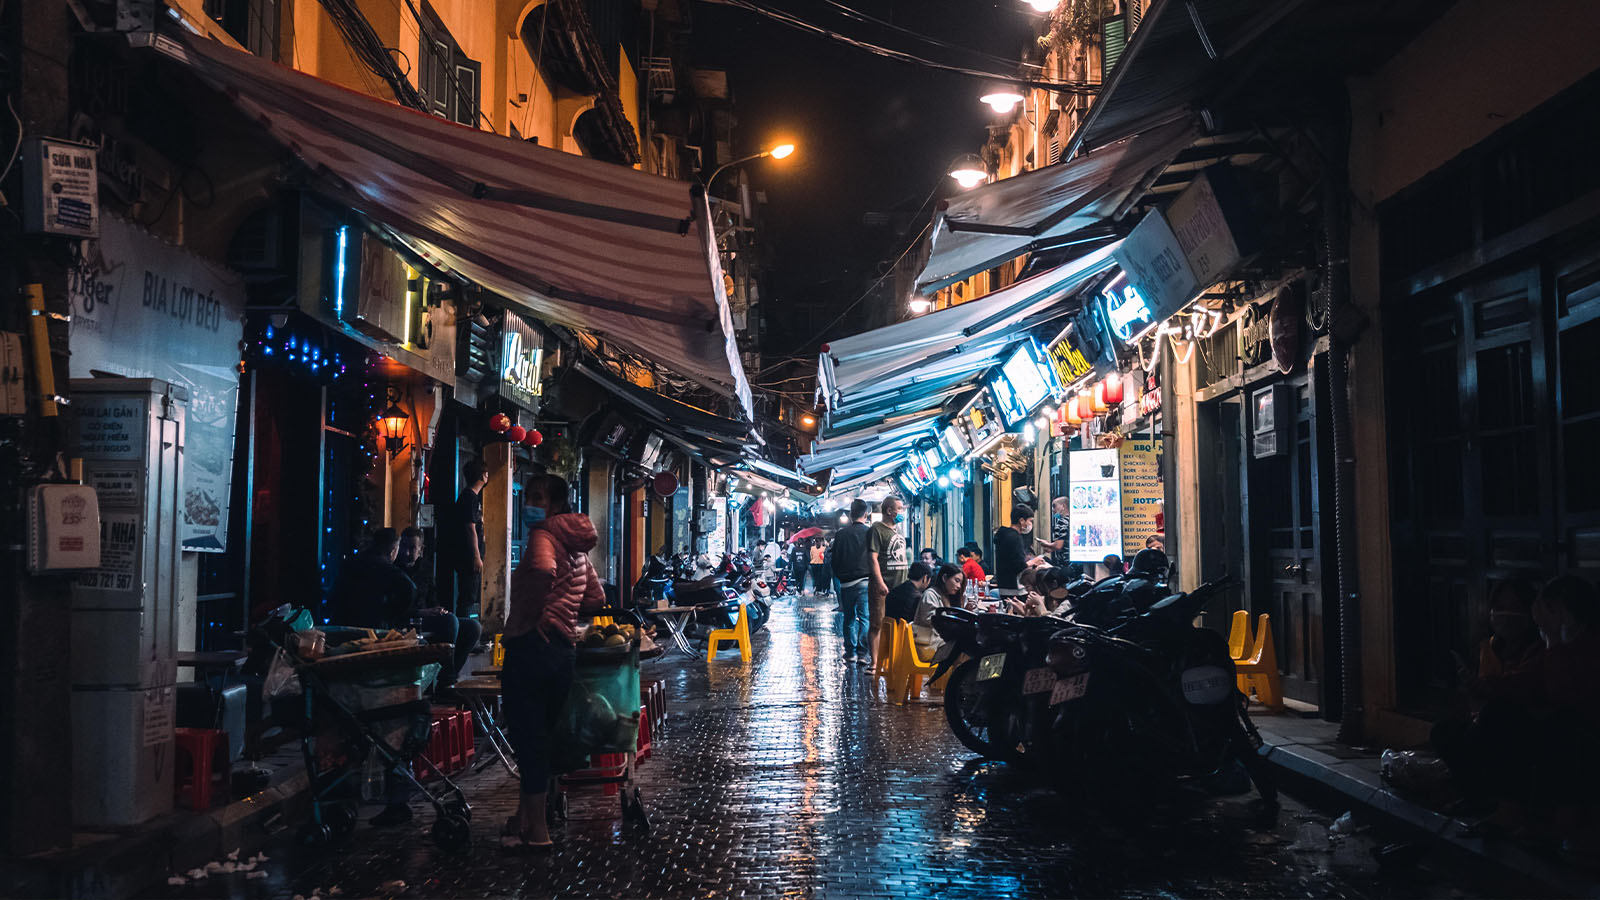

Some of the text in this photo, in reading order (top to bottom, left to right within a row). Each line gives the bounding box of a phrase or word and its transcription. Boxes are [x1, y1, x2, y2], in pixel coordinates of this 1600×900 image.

[143, 270, 167, 313] BIA
[196, 290, 221, 333] BÉO
[1133, 444, 1152, 453] BBQ
